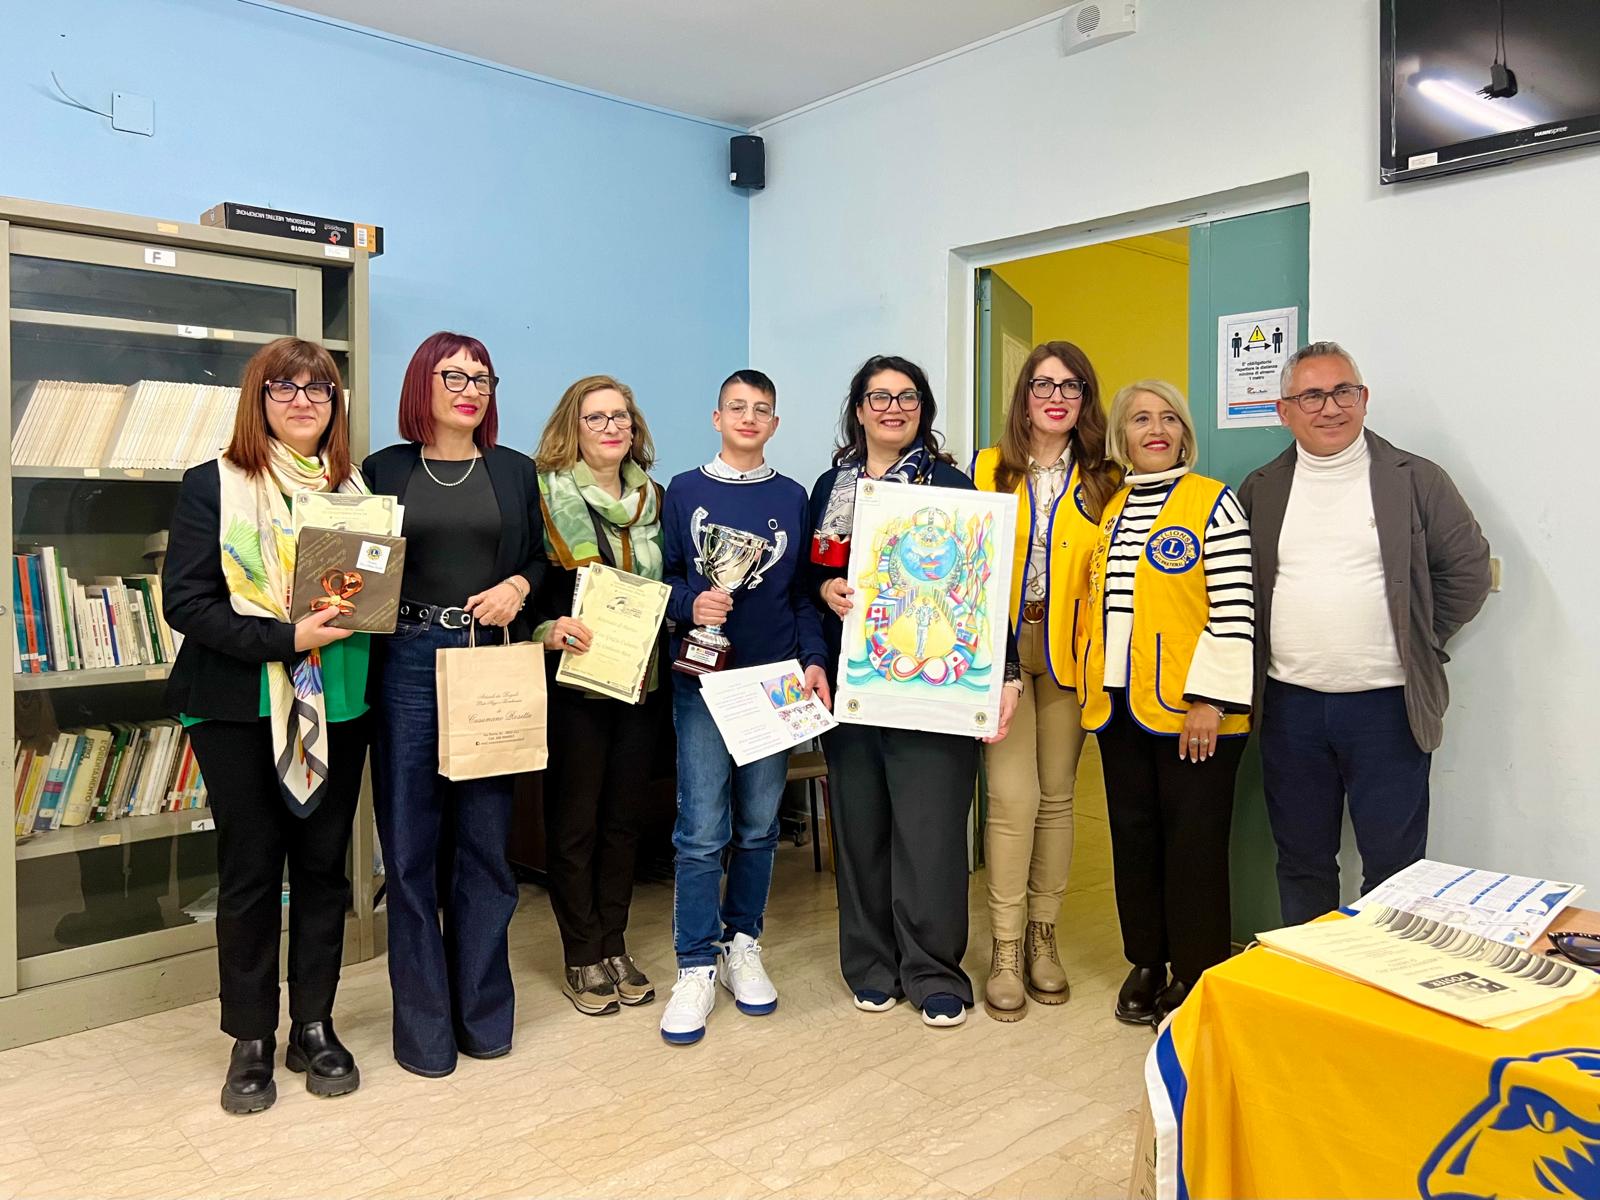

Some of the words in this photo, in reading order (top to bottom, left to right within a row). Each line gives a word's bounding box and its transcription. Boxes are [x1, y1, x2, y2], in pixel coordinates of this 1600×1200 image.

[152, 251, 162, 263] F
[1164, 529, 1191, 543] LIONS
[1165, 539, 1180, 556] L
